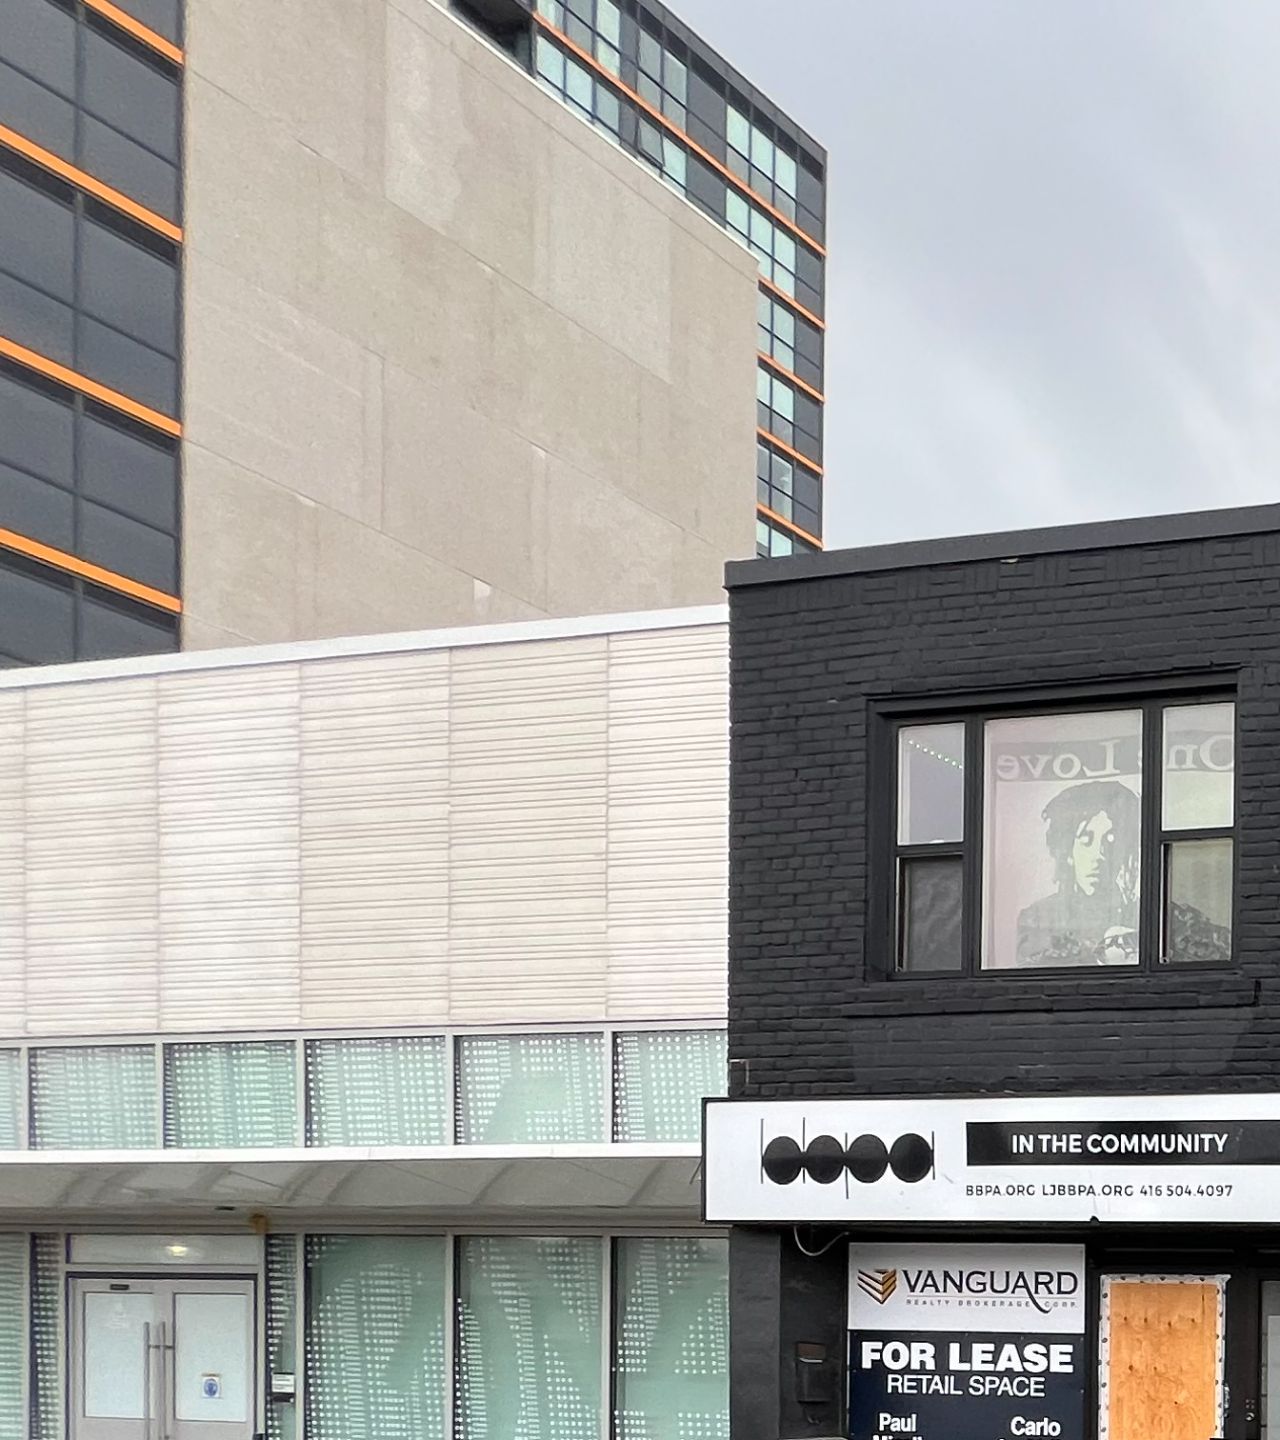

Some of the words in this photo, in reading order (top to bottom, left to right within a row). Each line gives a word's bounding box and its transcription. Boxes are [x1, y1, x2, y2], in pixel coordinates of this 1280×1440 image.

[1012, 1134, 1034, 1153] IN
[1038, 1134, 1083, 1153] THE
[1086, 1133, 1229, 1153] COMMUNITY
[966, 1184, 1036, 1197] BBPA.ORG
[1042, 1184, 1134, 1198] LJBBPA.ORG
[1140, 1184, 1163, 1197] 416
[1166, 1184, 1233, 1198] 504.4097
[901, 1269, 1078, 1314] VANGUARD
[861, 1341, 936, 1371] FOR
[949, 1342, 1074, 1373] LEASE
[887, 1374, 963, 1395] RETAIL
[968, 1376, 1045, 1397] SPACE
[879, 1412, 917, 1432] Paul
[1010, 1416, 1061, 1437] Carlo
